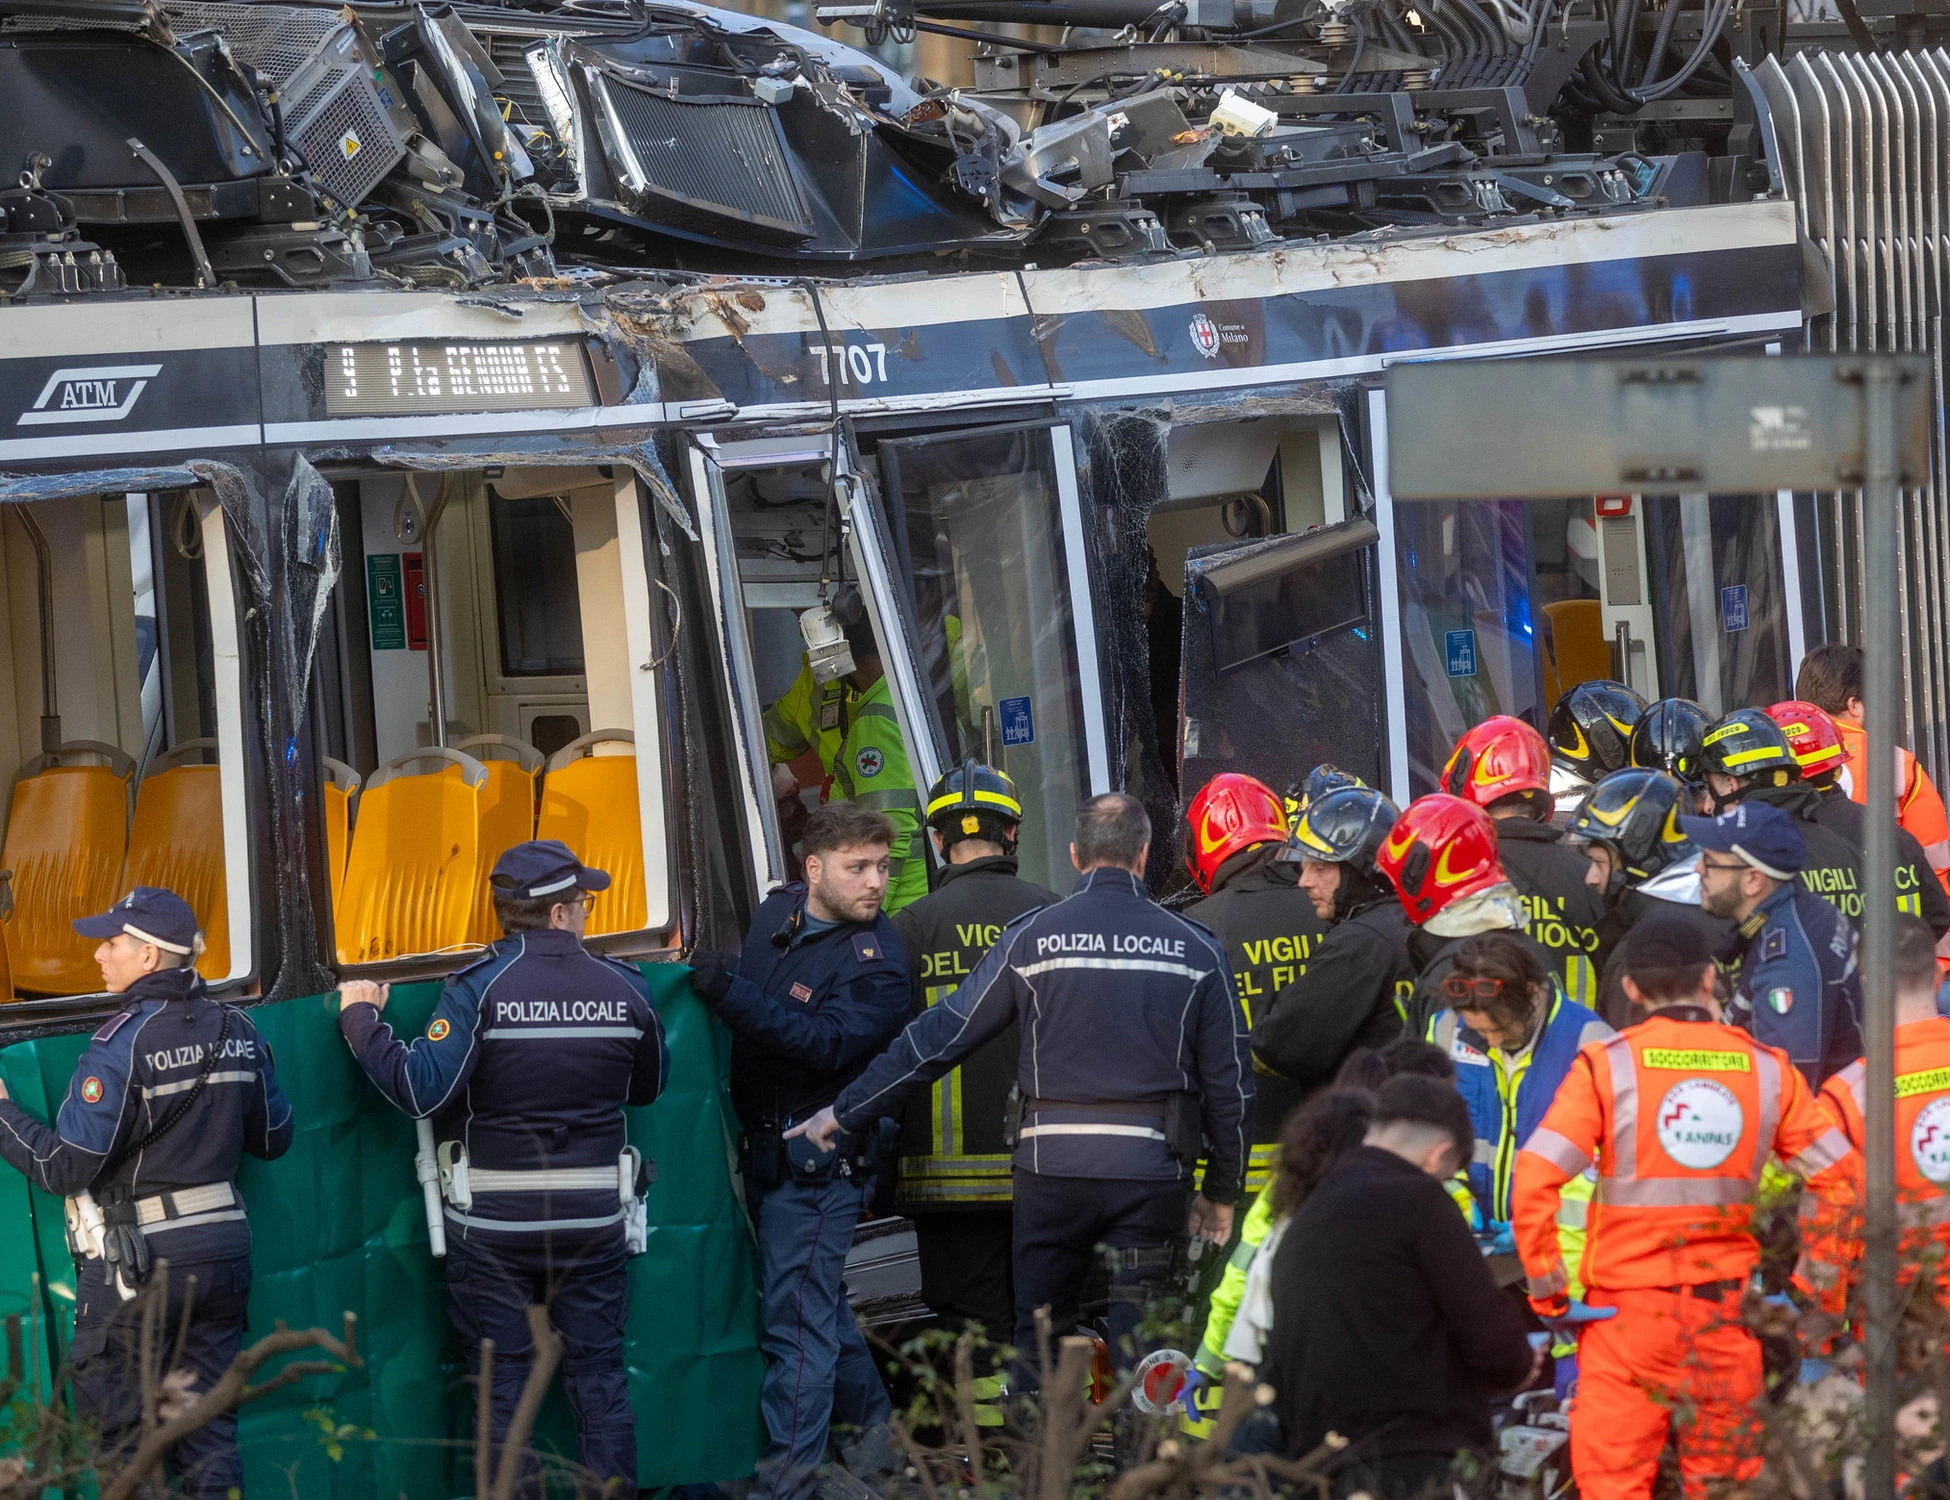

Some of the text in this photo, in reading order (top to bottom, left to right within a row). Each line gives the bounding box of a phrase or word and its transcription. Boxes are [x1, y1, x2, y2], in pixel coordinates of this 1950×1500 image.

[1221, 332, 1249, 343] Milano
[808, 343, 888, 384] 7707
[60, 380, 118, 409] ATM
[1800, 867, 1857, 893] VIGILI
[955, 923, 1008, 948] VIG
[1036, 933, 1187, 958] POLIZIA LOCALE
[496, 1000, 628, 1022] POLIZIA LOCALE
[145, 1043, 204, 1073] POLIZIA
